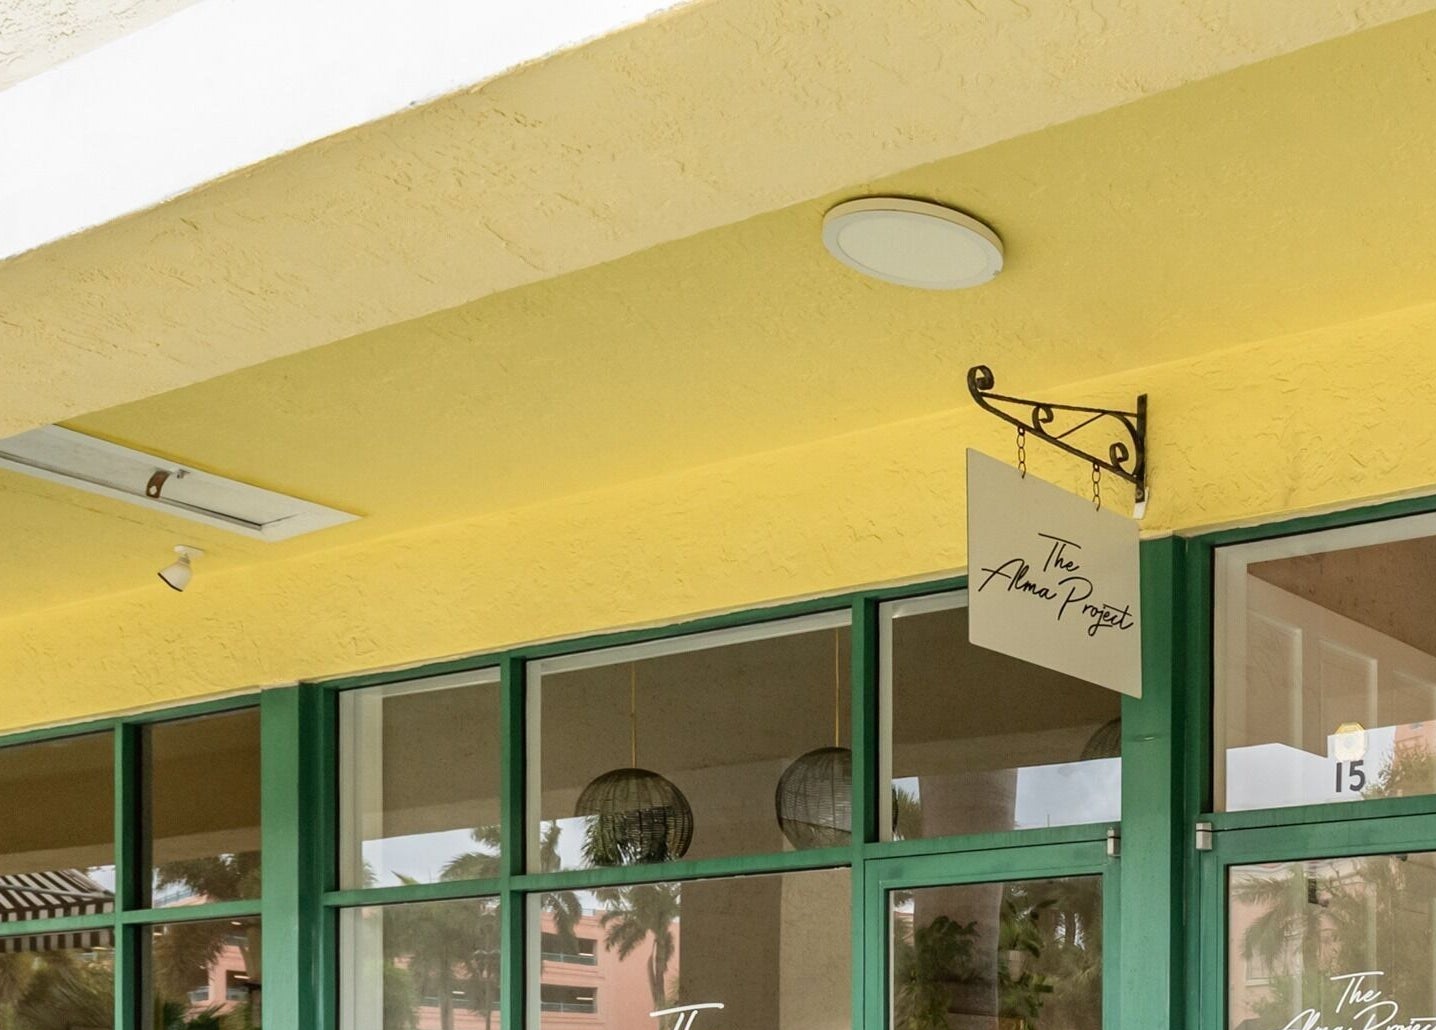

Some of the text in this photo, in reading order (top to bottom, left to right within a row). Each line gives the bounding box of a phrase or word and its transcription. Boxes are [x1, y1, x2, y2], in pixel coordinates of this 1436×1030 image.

[1038, 533, 1082, 573] The
[978, 558, 1134, 636] Alma Project
[1336, 759, 1366, 793] 15
[1329, 971, 1385, 1014] The
